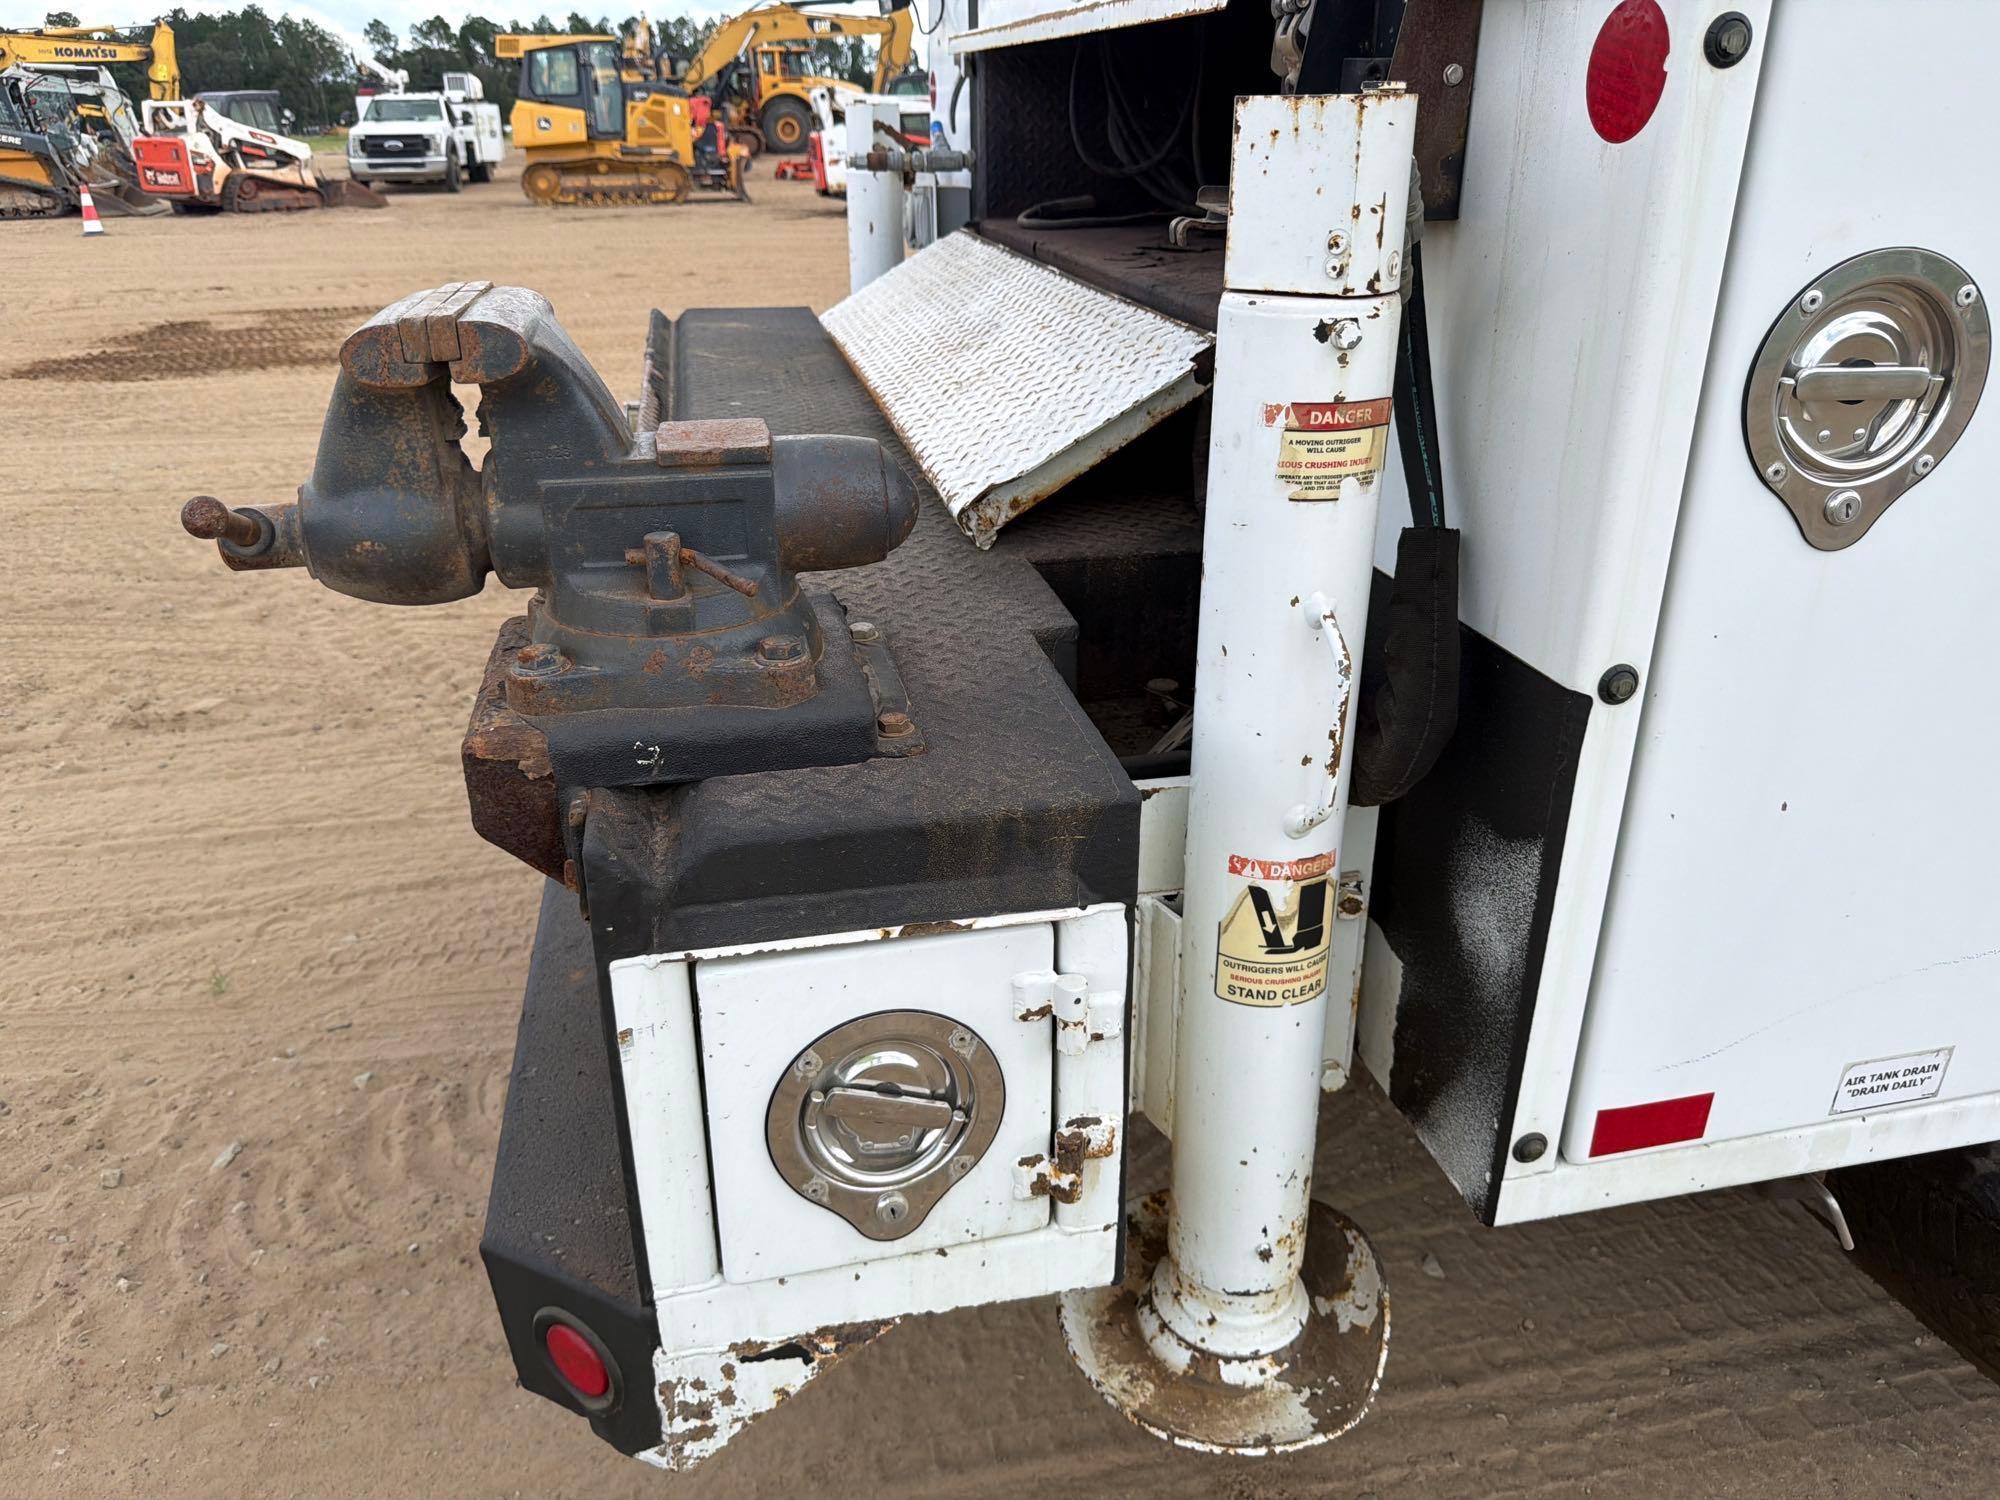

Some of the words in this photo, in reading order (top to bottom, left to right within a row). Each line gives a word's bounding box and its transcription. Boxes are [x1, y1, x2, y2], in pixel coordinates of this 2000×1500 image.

[54, 46, 117, 58] KOMATSU
[1310, 408, 1373, 425] DANGER
[1326, 437, 1361, 446] OUTRIGGER
[1304, 459, 1348, 469] CRUSHING
[1349, 457, 1373, 466] INJURY
[1270, 858, 1329, 877] DANGER
[1222, 959, 1284, 975] OUTRIGGERS
[1285, 964, 1305, 974] WILL
[1306, 954, 1327, 970] CAUSE
[1230, 973, 1264, 985] SERIOUS
[1264, 976, 1302, 986] CRUSHING
[1303, 968, 1322, 982] INJURY
[1227, 984, 1277, 1001] STAND
[1282, 979, 1322, 1000] CLEAR
[1844, 1075, 1866, 1087] AIR
[1869, 1069, 1902, 1083] TANK
[1902, 1063, 1941, 1077] DRAIN
[1846, 1083, 1890, 1098] "DRAIN
[1891, 1075, 1932, 1090] DAILY"
